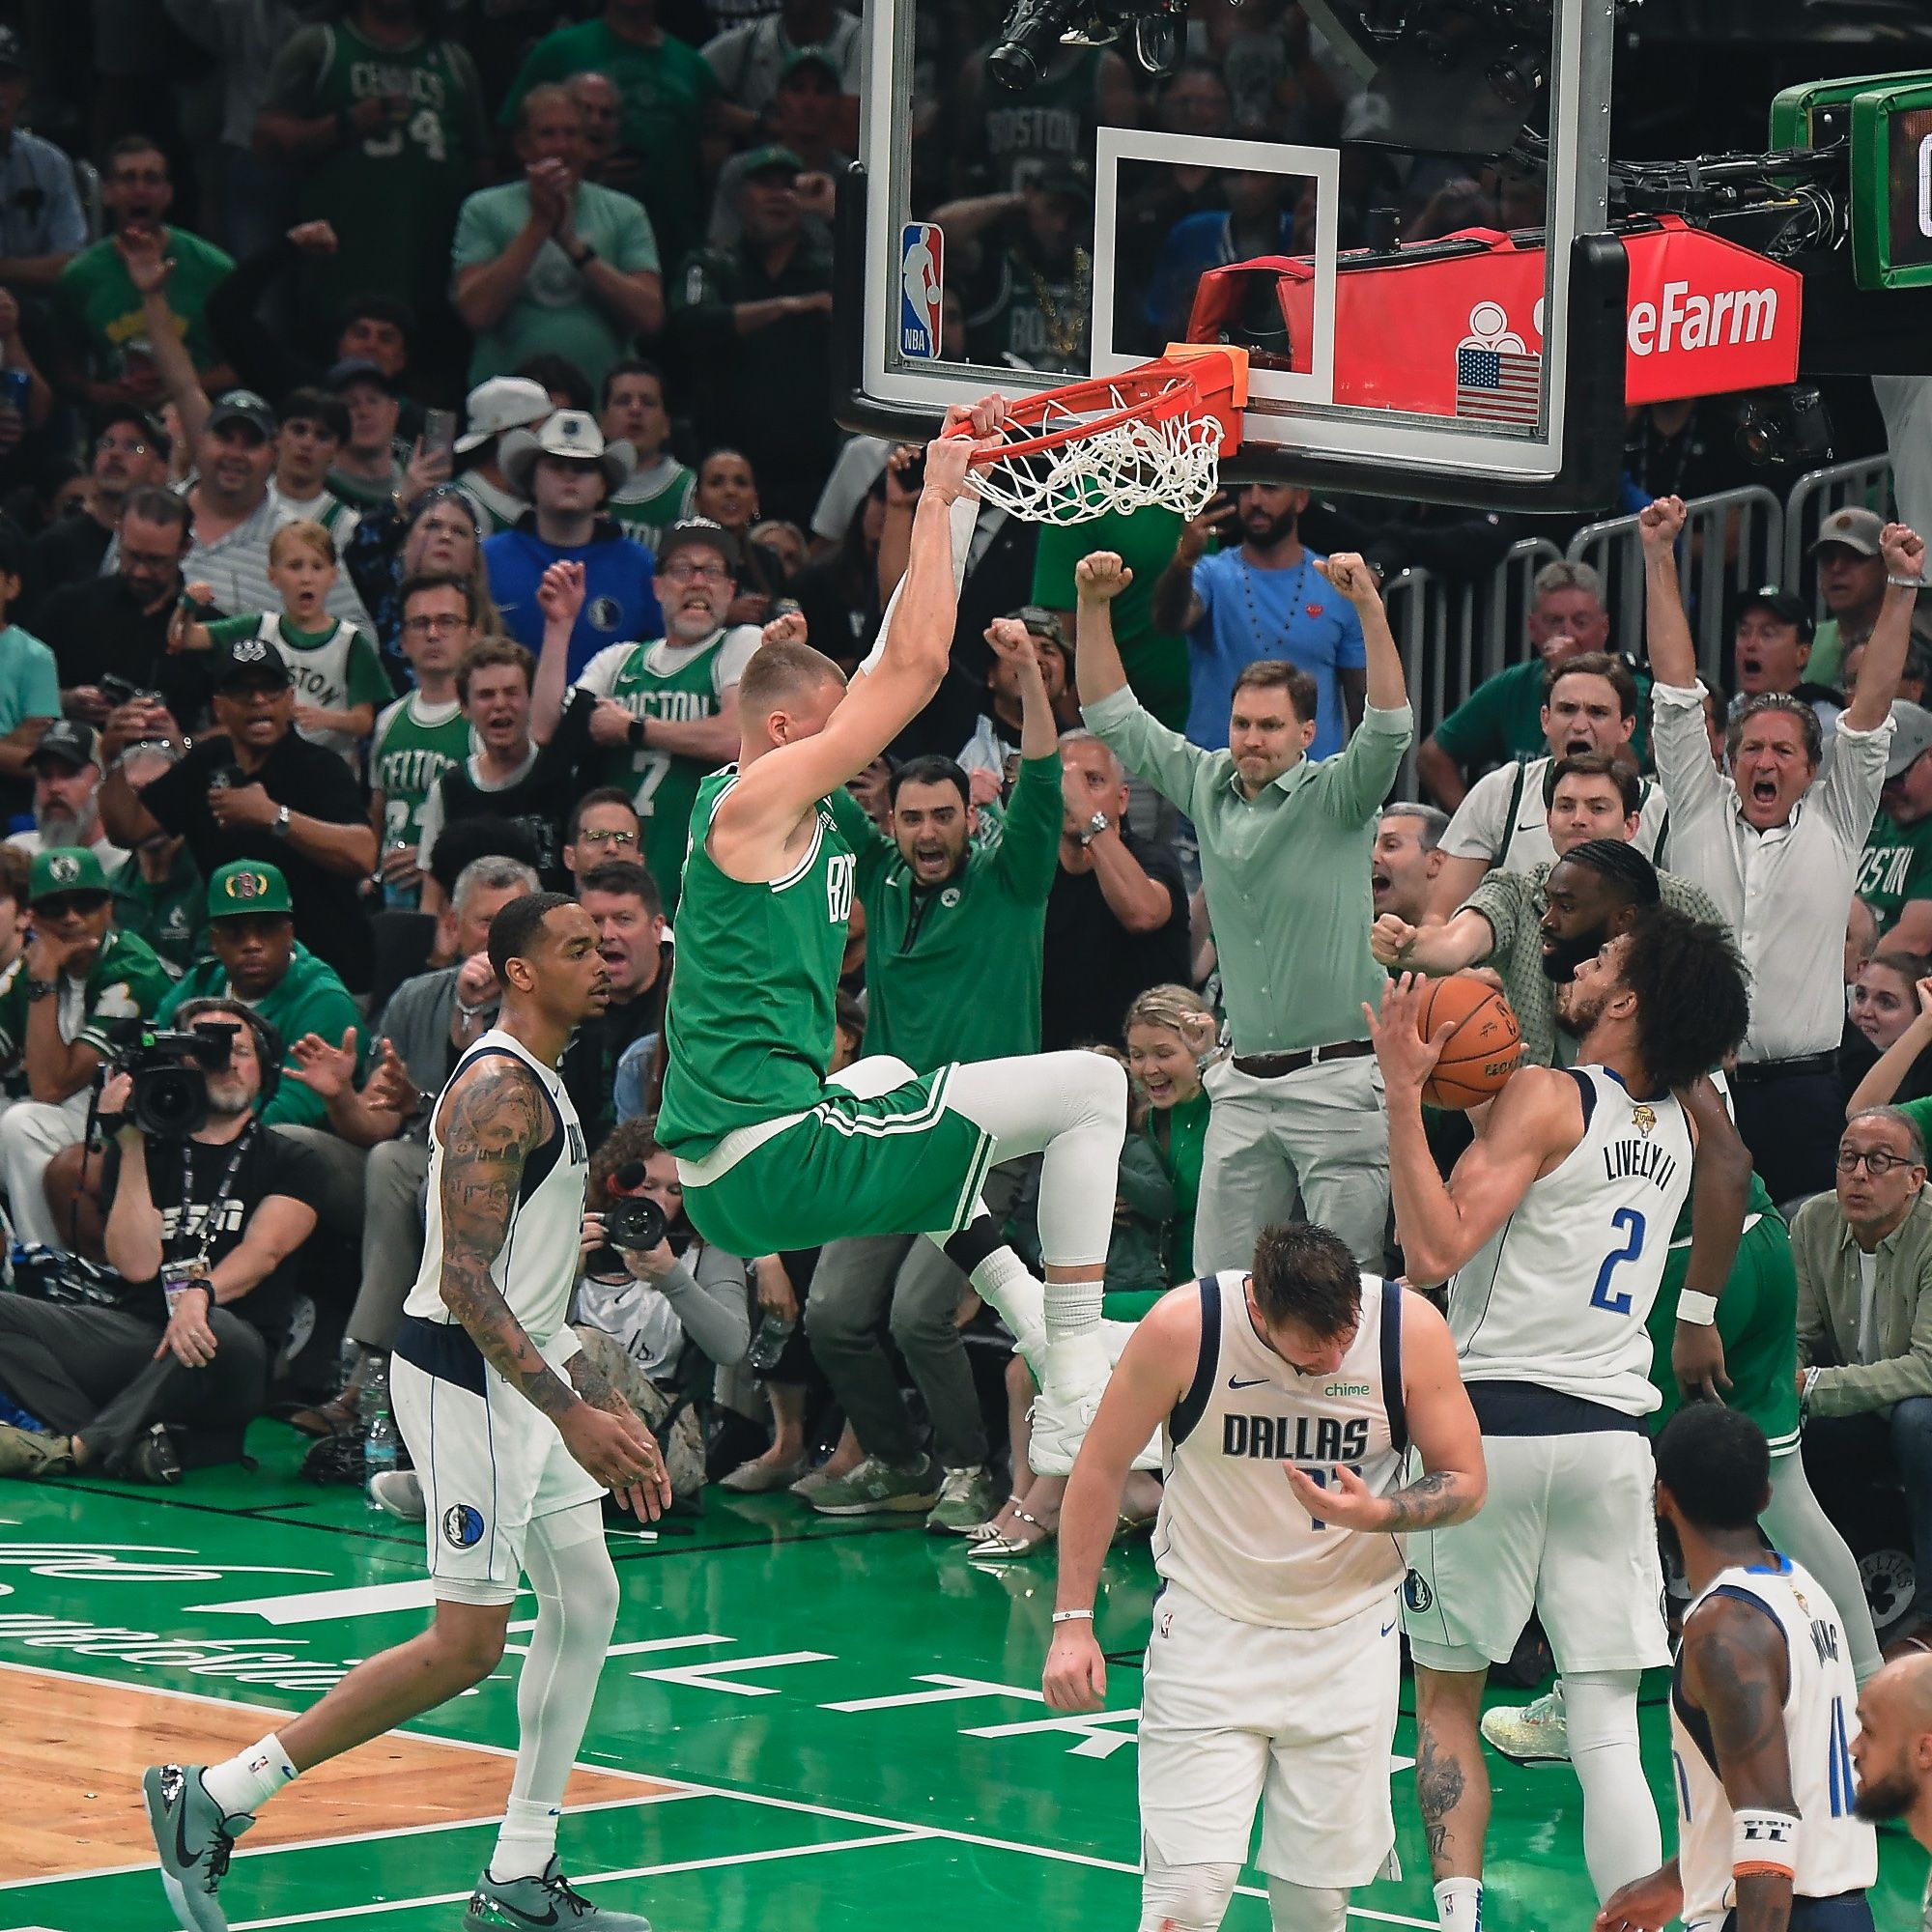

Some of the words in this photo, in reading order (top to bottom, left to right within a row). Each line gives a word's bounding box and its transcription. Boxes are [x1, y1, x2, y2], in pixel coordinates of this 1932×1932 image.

[904, 328, 924, 351] NBA
[632, 750, 671, 816] 7
[1603, 1139, 1663, 1181] LIVELY
[1656, 1154, 1677, 1192] II
[1589, 1206, 1647, 1317] 2
[1324, 1382, 1370, 1397] chime
[1222, 1413, 1370, 1463] DALLAS
